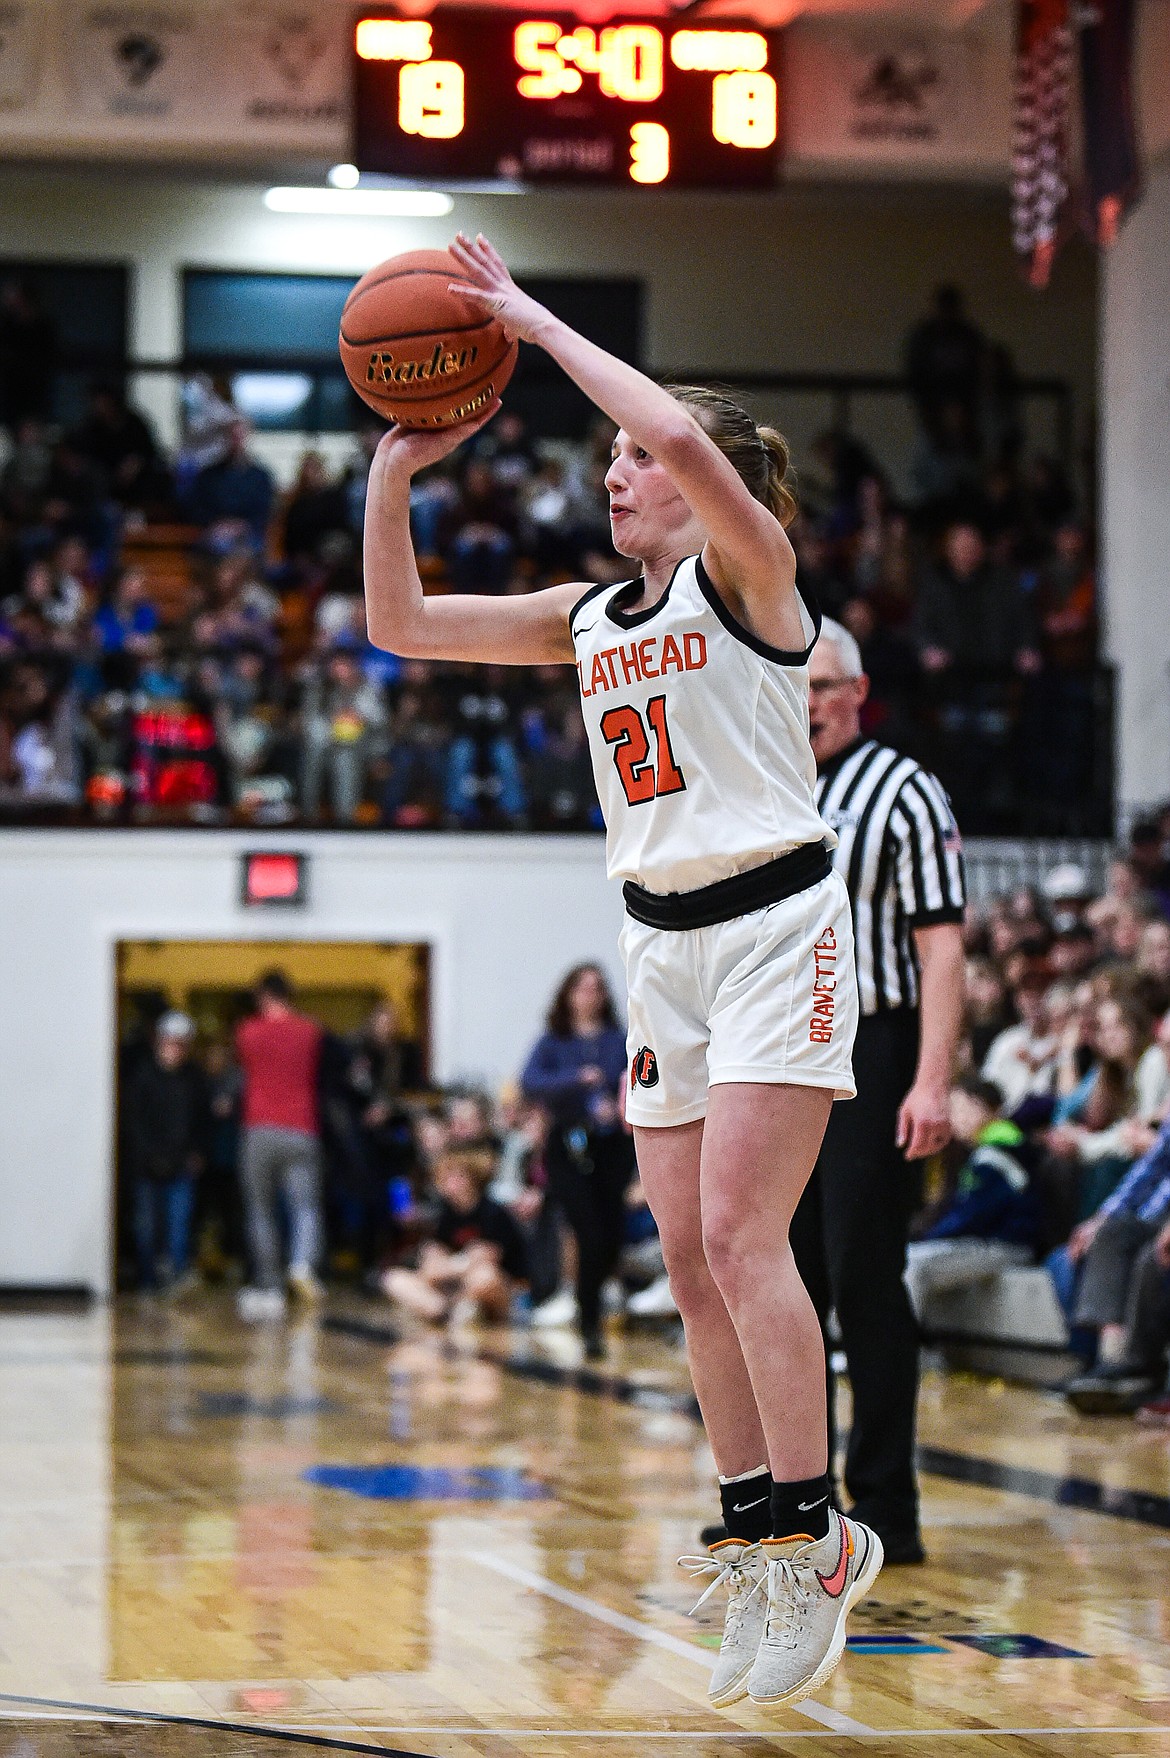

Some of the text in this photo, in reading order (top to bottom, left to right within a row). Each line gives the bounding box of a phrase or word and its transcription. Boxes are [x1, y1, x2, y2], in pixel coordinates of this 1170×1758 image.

[366, 342, 478, 384] Baden
[576, 632, 708, 698] LATHEAD
[600, 694, 687, 807] 21
[809, 926, 837, 1043] BRAVETTES
